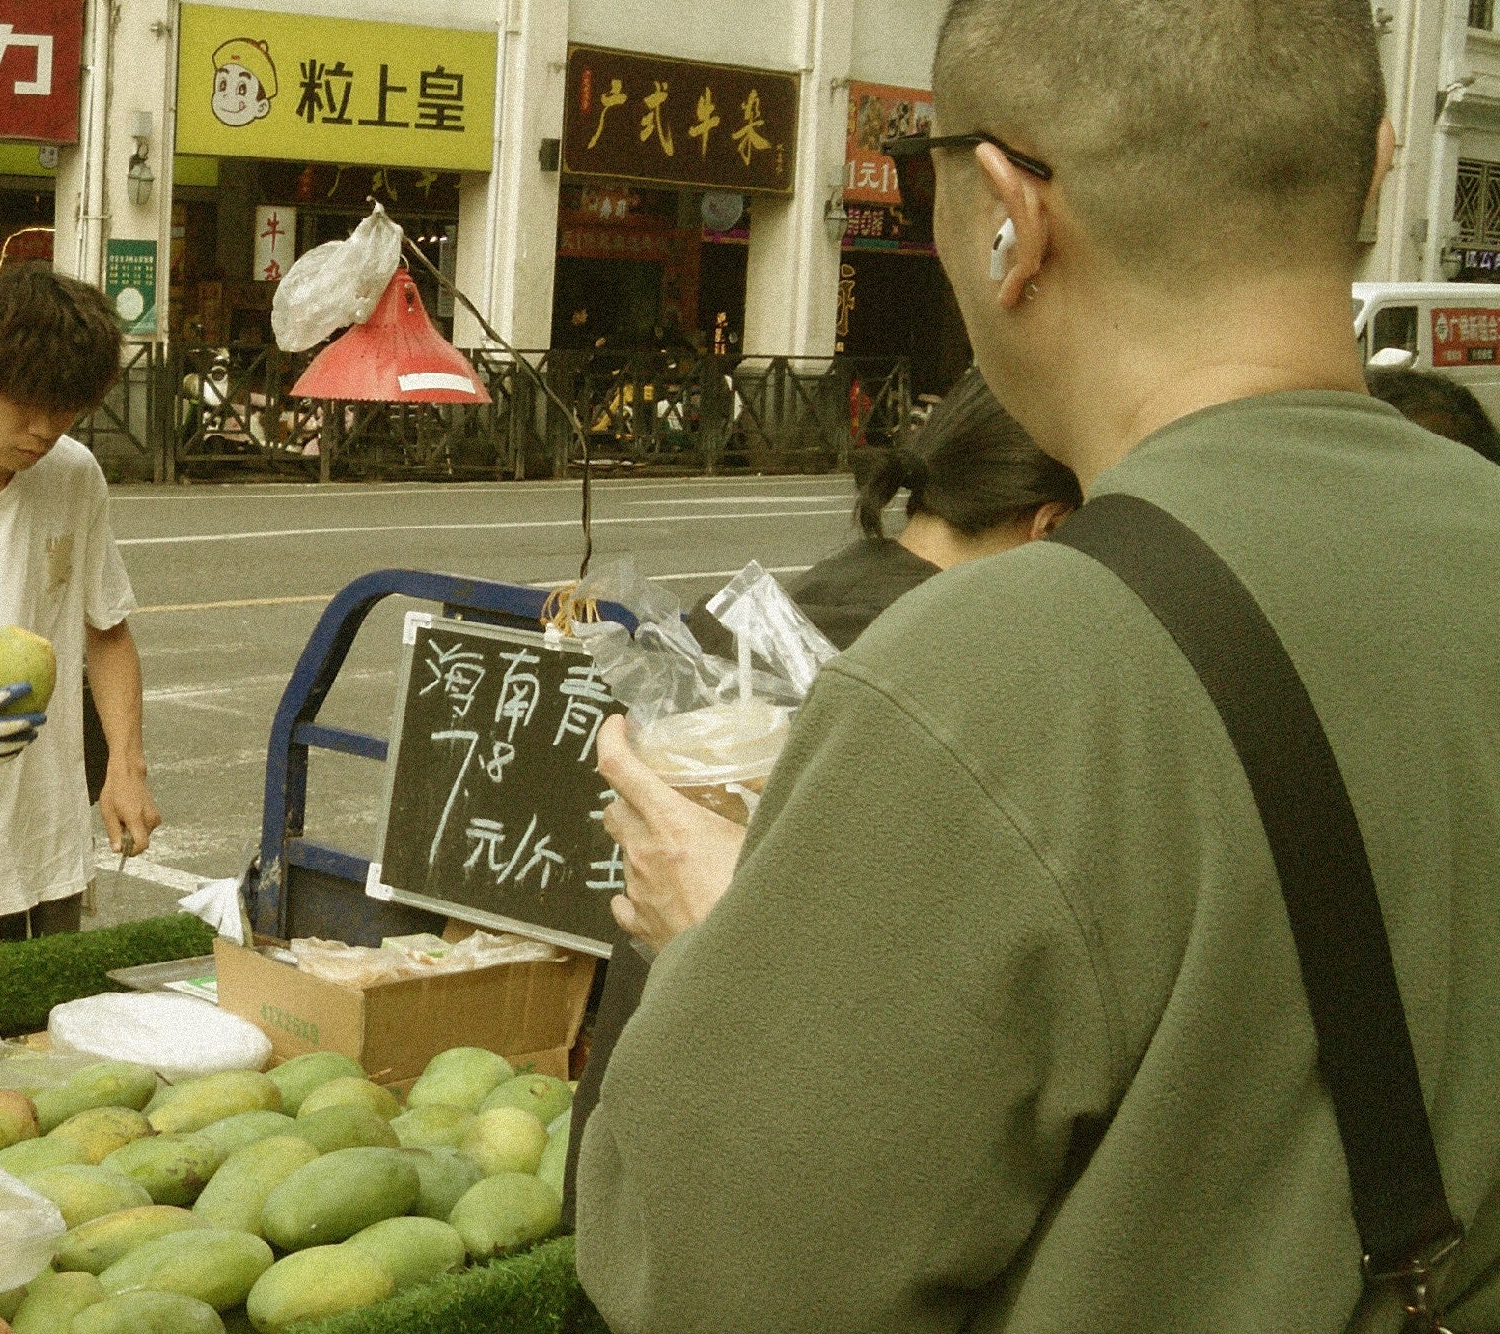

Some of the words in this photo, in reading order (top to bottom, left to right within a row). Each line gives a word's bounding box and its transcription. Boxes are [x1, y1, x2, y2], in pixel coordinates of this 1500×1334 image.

[296, 58, 467, 133] 粒上皇
[587, 78, 772, 167] 广式牛杂
[419, 639, 617, 762] 海南青
